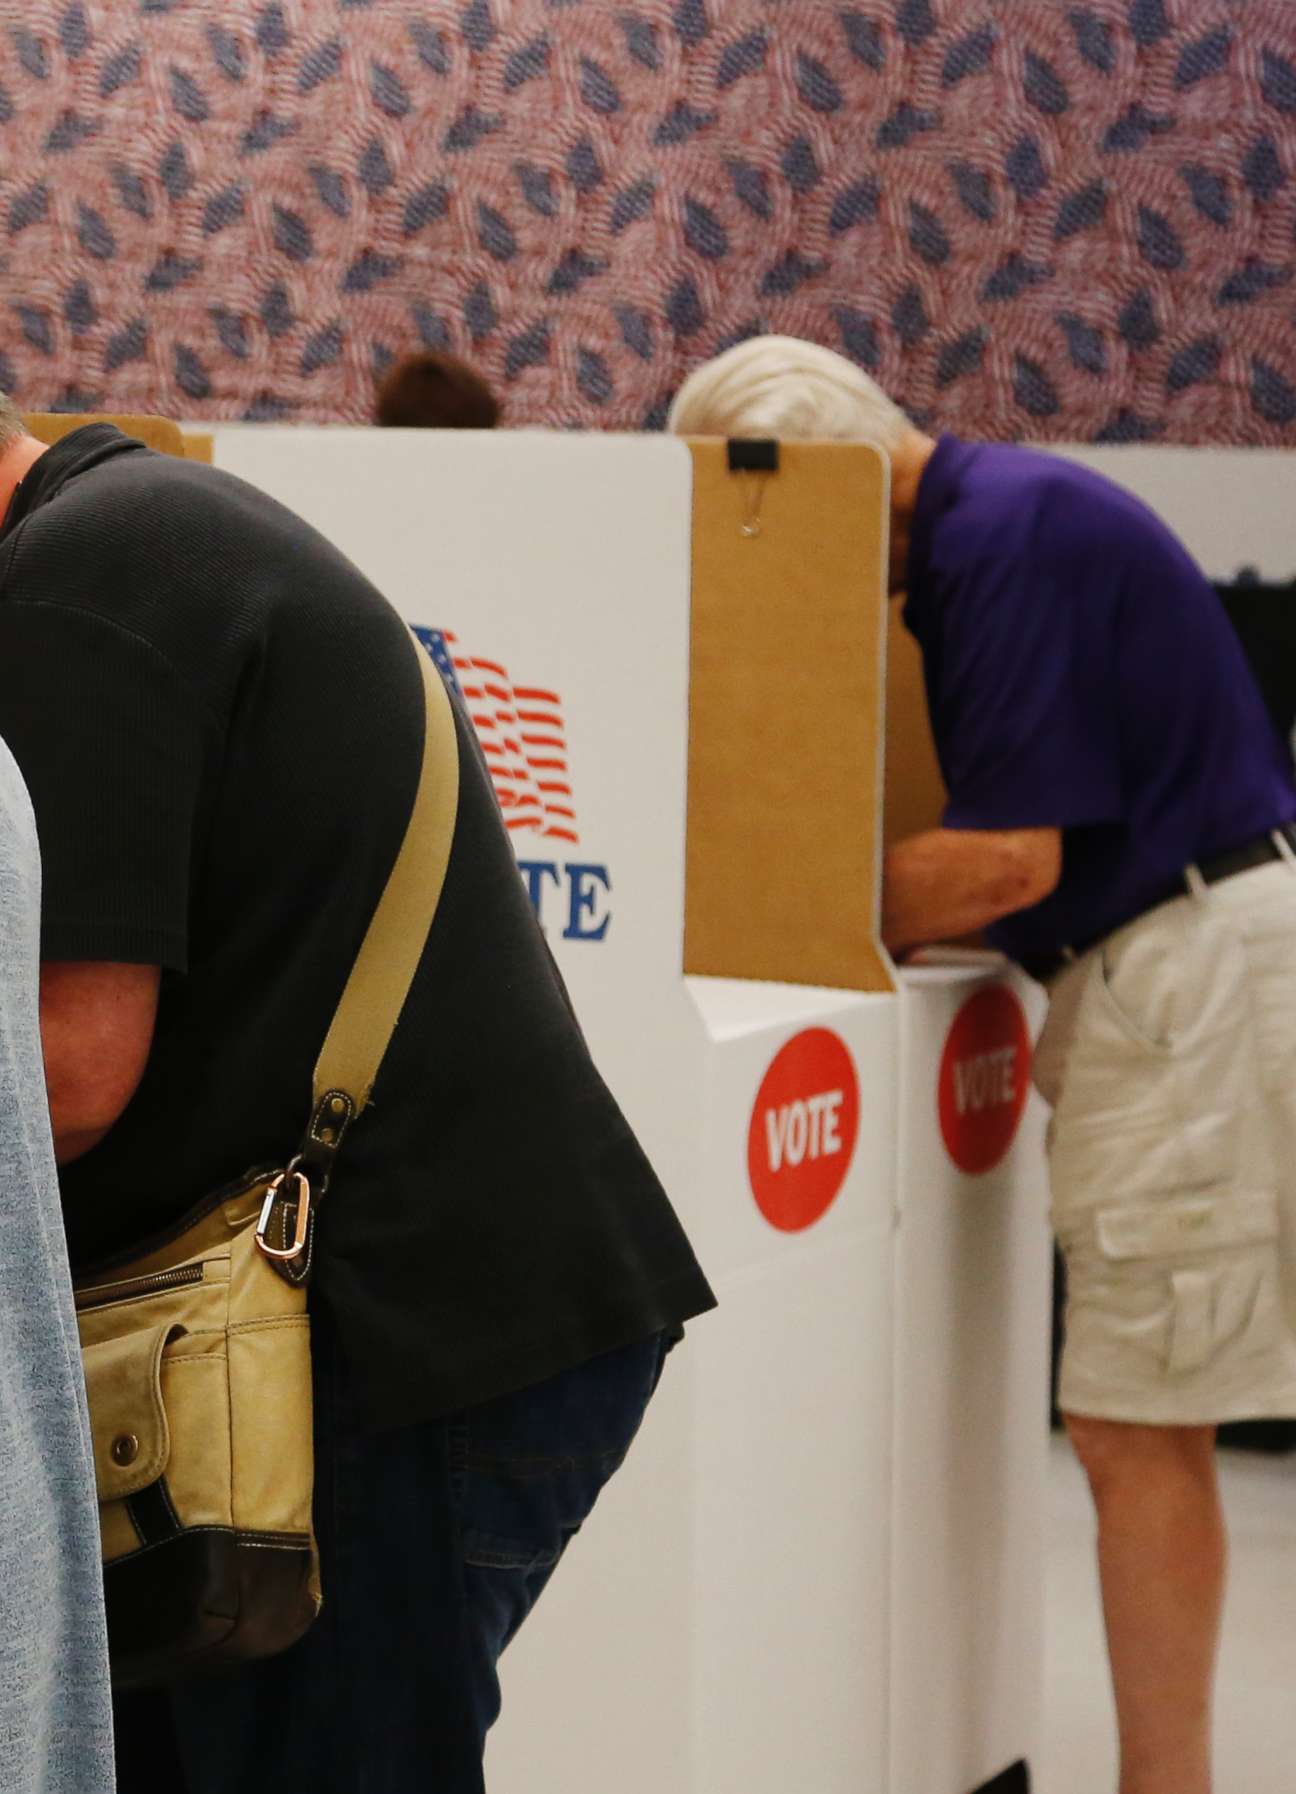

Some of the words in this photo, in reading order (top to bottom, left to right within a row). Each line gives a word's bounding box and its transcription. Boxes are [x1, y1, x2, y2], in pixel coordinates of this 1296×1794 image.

[516, 860, 611, 941] TE
[955, 1047, 1016, 1115] VOTE
[765, 1089, 843, 1172] VOTE
